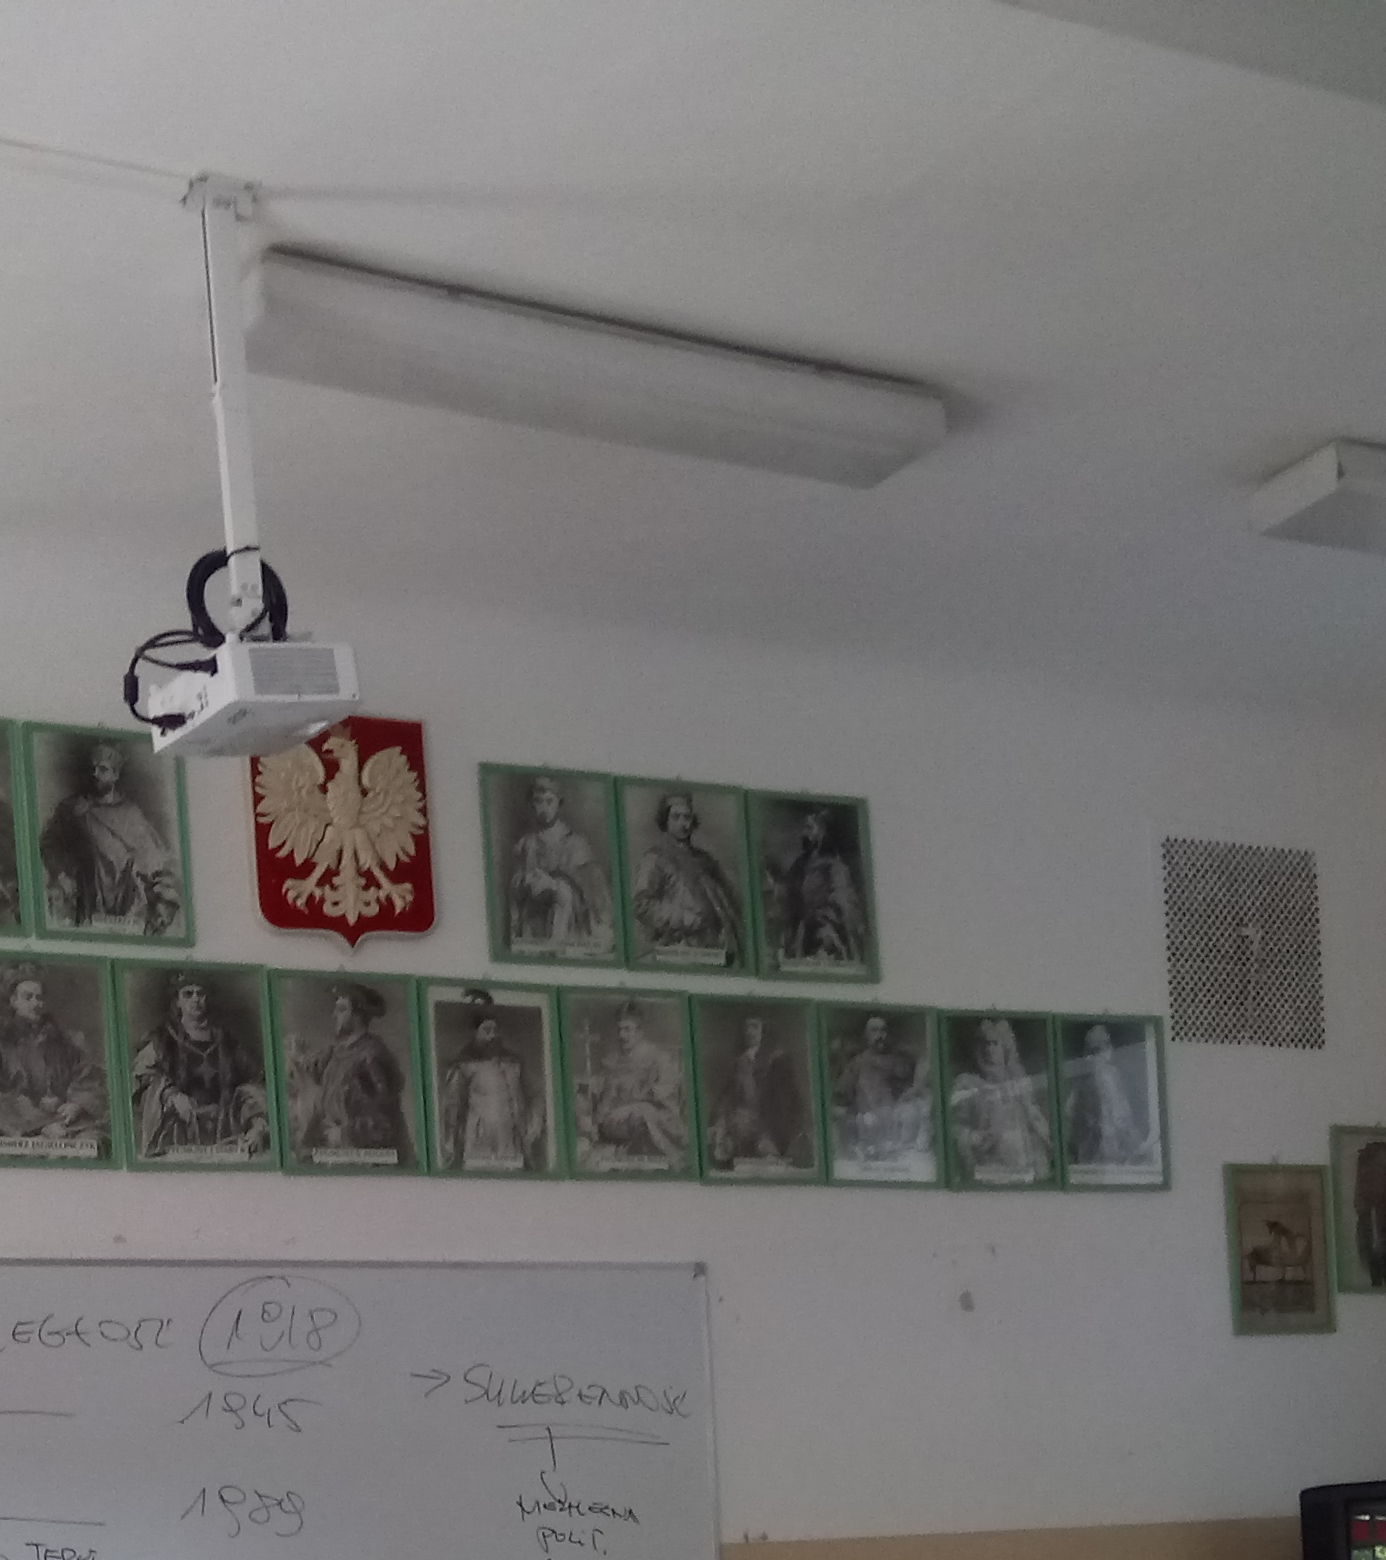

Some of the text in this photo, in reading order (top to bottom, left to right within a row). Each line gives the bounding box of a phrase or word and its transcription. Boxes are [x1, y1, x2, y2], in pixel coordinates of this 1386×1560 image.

[226, 1301, 338, 1352] 1918
[177, 1391, 323, 1433] 1945
[180, 1485, 305, 1539] 1989
